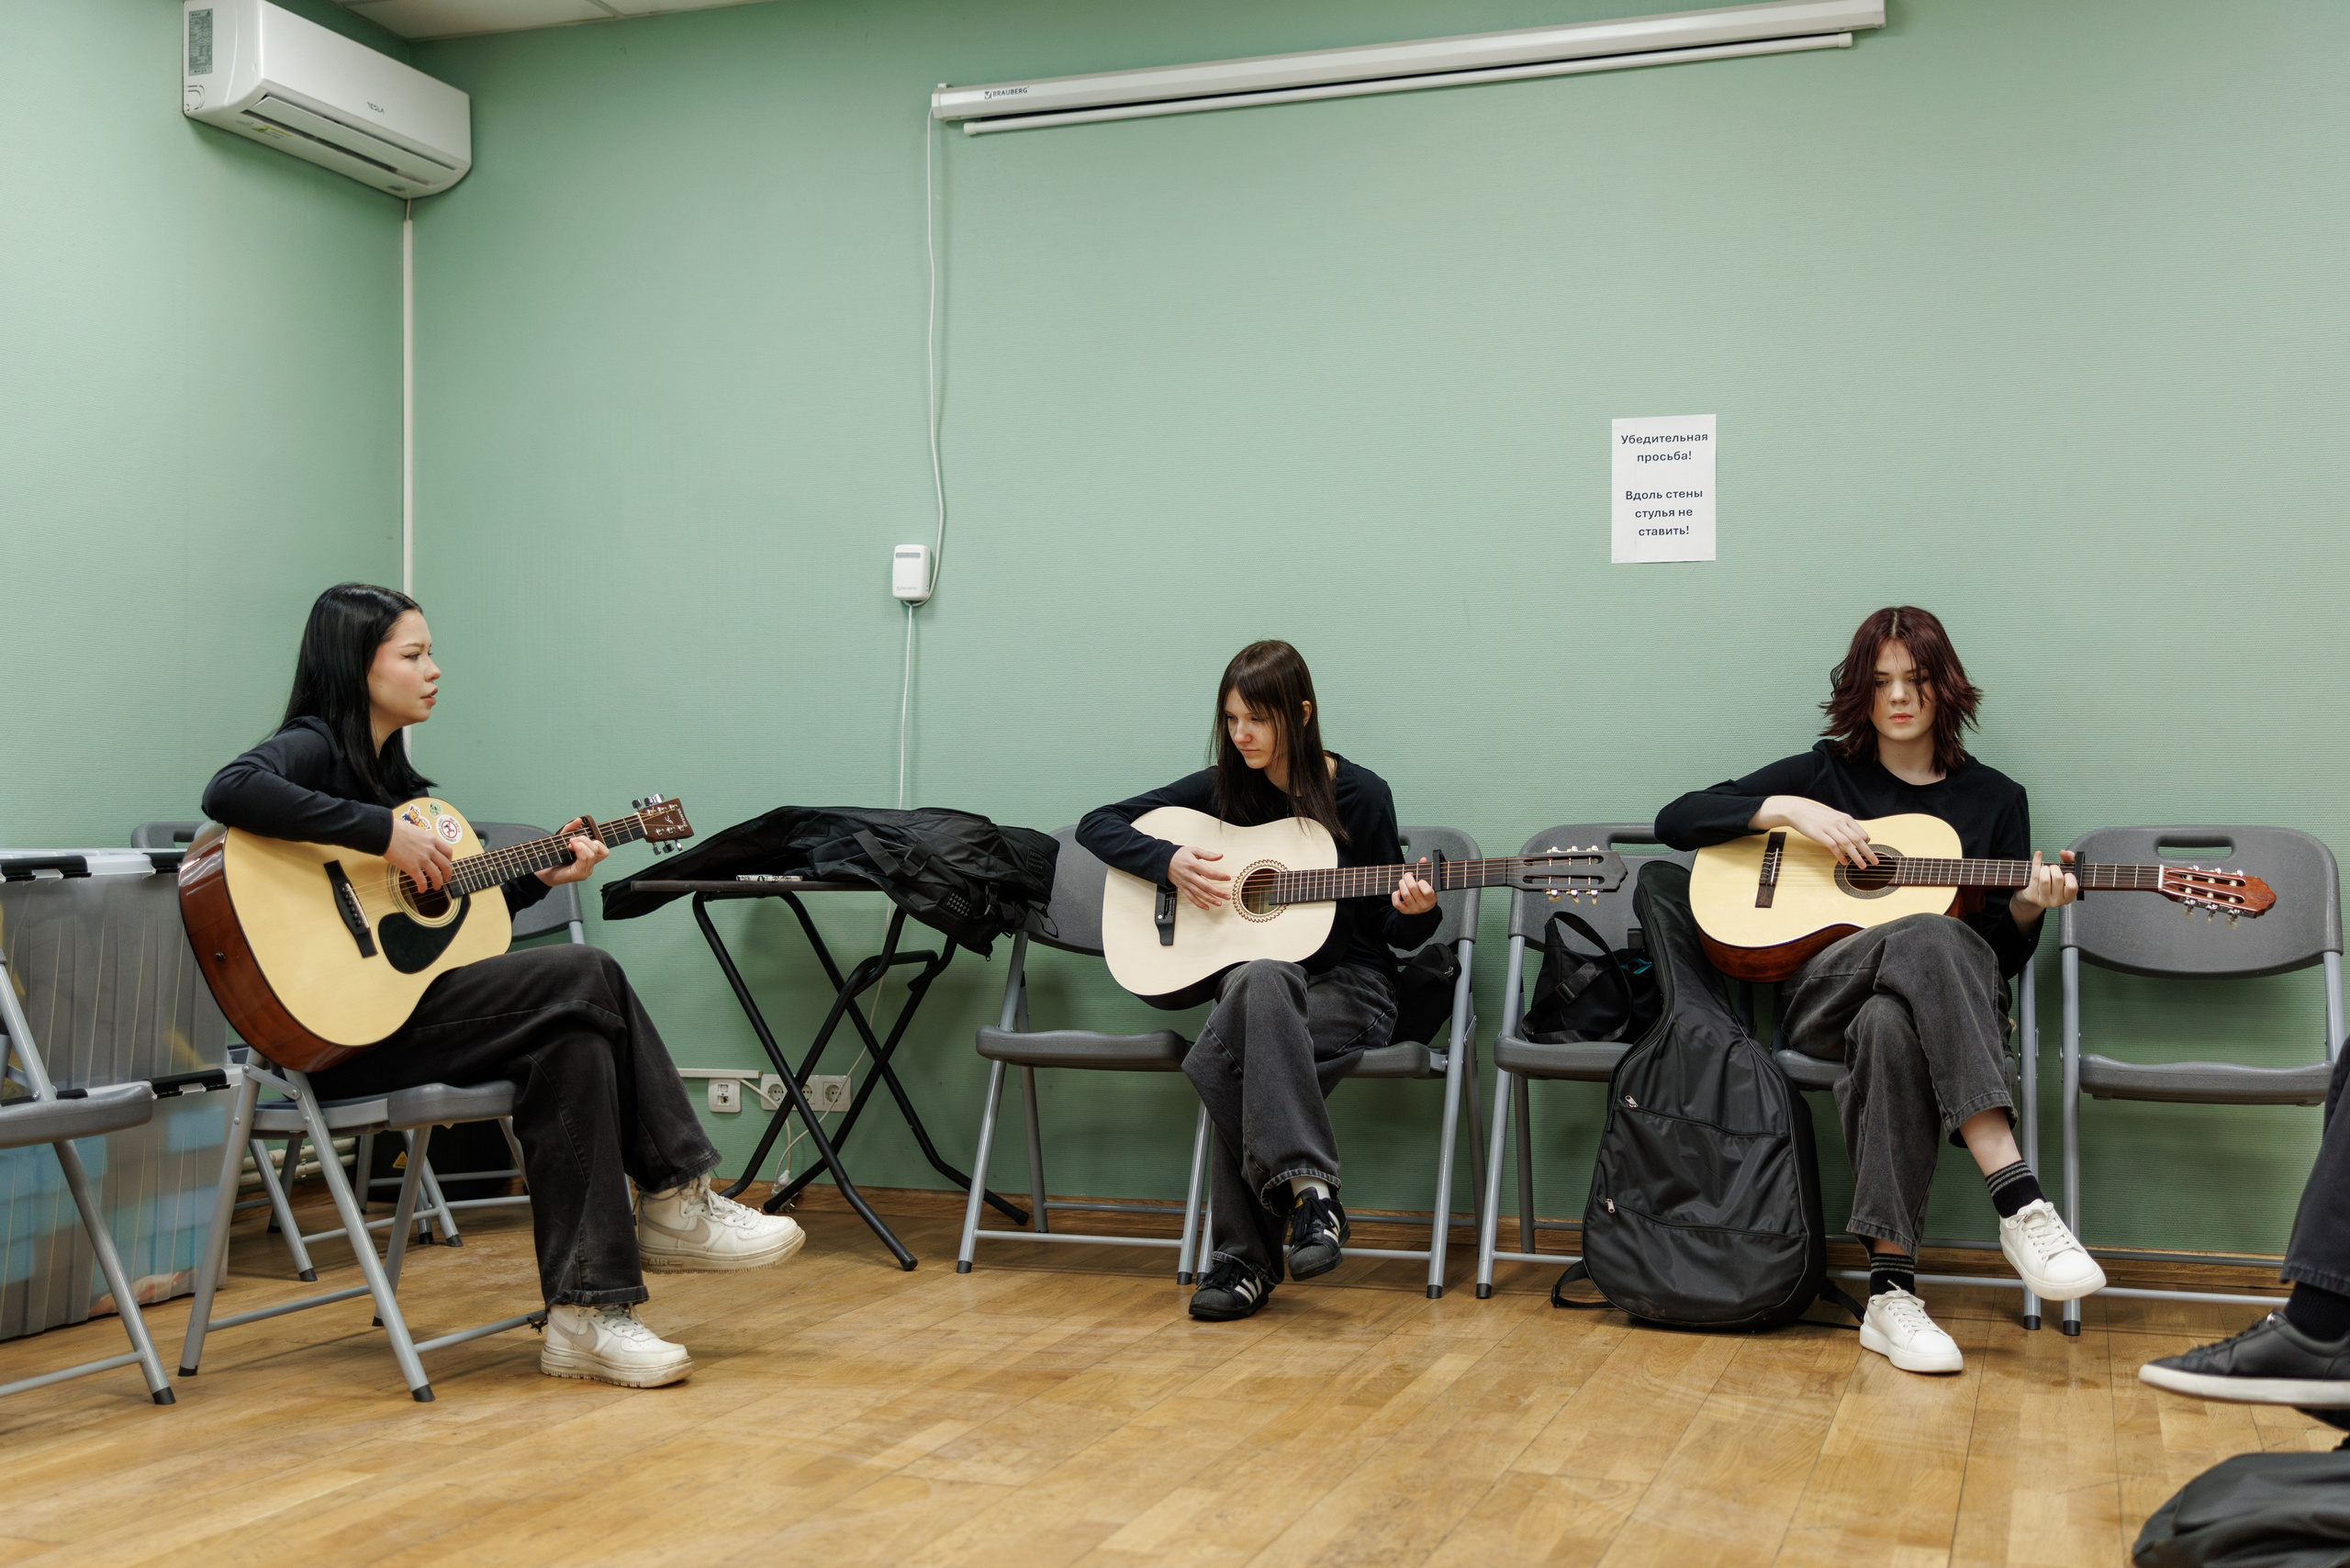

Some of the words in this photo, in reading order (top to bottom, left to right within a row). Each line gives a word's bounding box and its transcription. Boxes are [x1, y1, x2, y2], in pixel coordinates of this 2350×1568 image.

[992, 87, 1028, 97] BRAUBERG
[1621, 433, 1708, 444] Убедительная
[1637, 451, 1692, 464] просьба!
[1626, 490, 1662, 501] Вдоль
[1665, 490, 1703, 498] стены
[1635, 510, 1675, 521] стулья
[1678, 509, 1693, 517] не
[1638, 525, 1689, 536] ставить!
[648, 1258, 668, 1266] AIR
